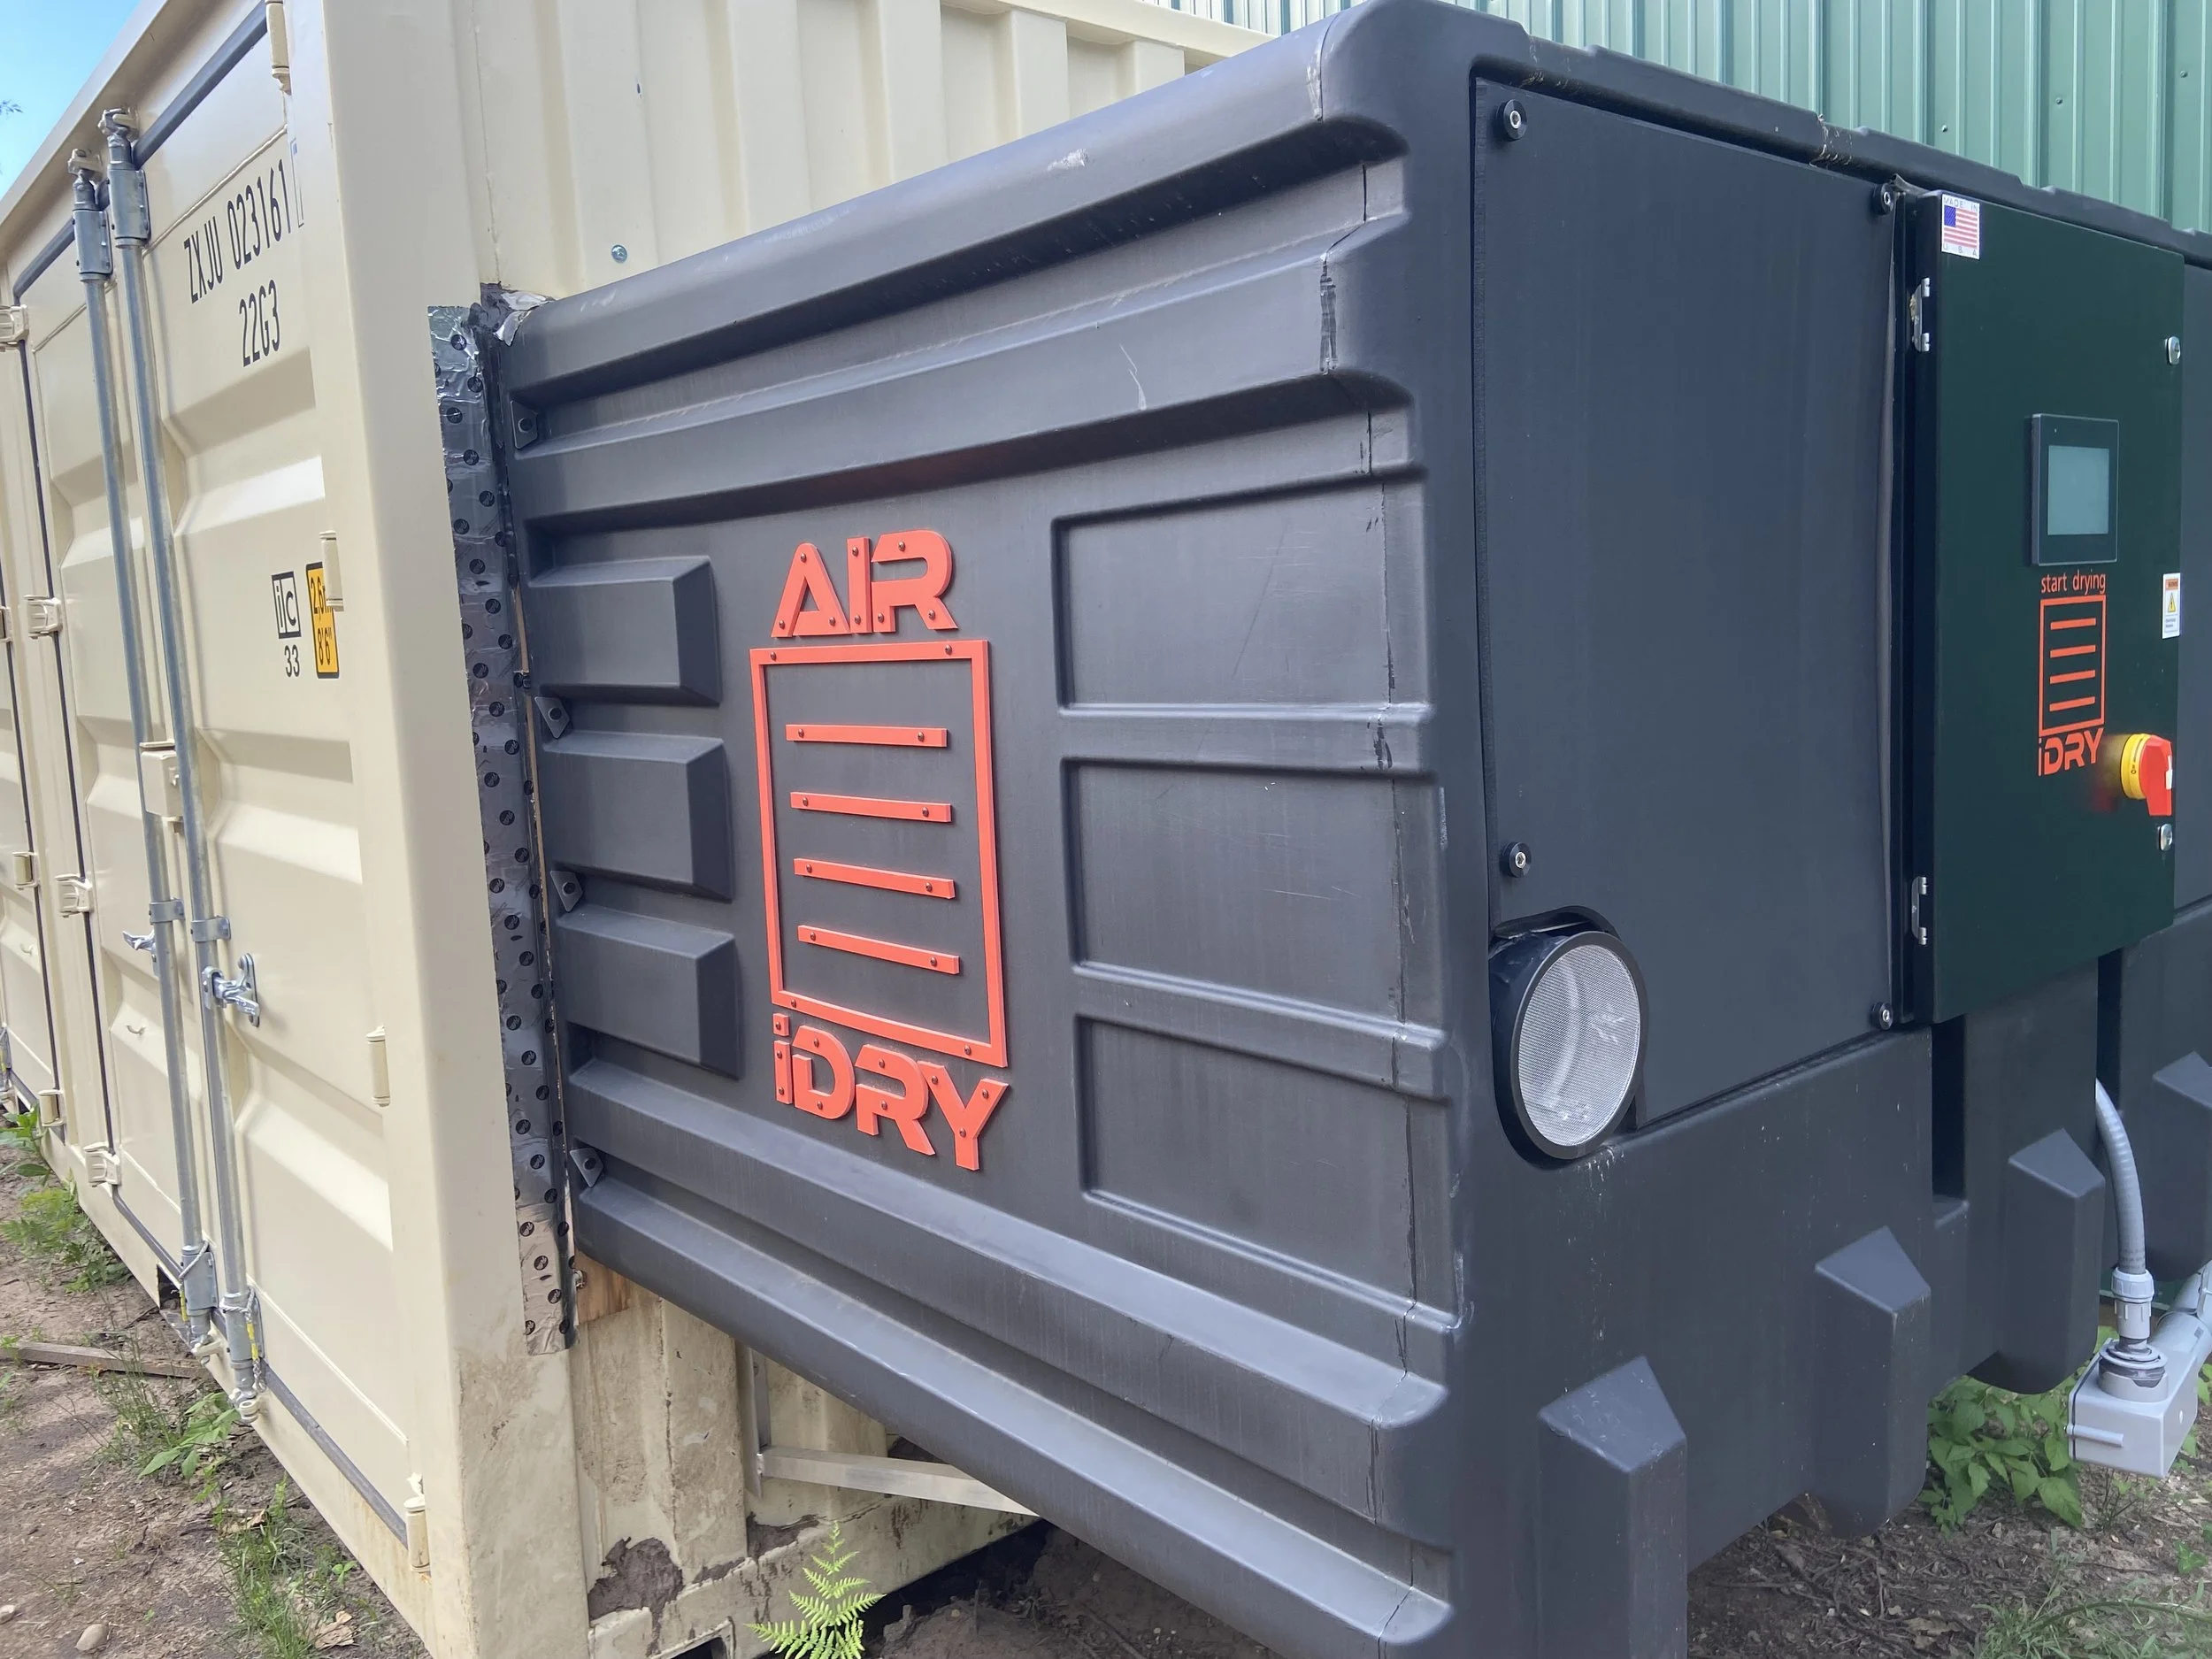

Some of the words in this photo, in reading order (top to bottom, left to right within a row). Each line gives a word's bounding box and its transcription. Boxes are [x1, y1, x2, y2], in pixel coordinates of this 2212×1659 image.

[183, 216, 223, 303] ZXJU
[227, 158, 291, 270] 023161
[1943, 196, 1963, 208] MADE
[239, 280, 280, 367] 22G3
[771, 529, 958, 638] AIR
[2040, 573, 2068, 594] start
[2072, 569, 2106, 595] drying
[284, 644, 300, 678] 33
[2038, 727, 2104, 777] iDRY
[772, 1012, 1010, 1171] iDRY
